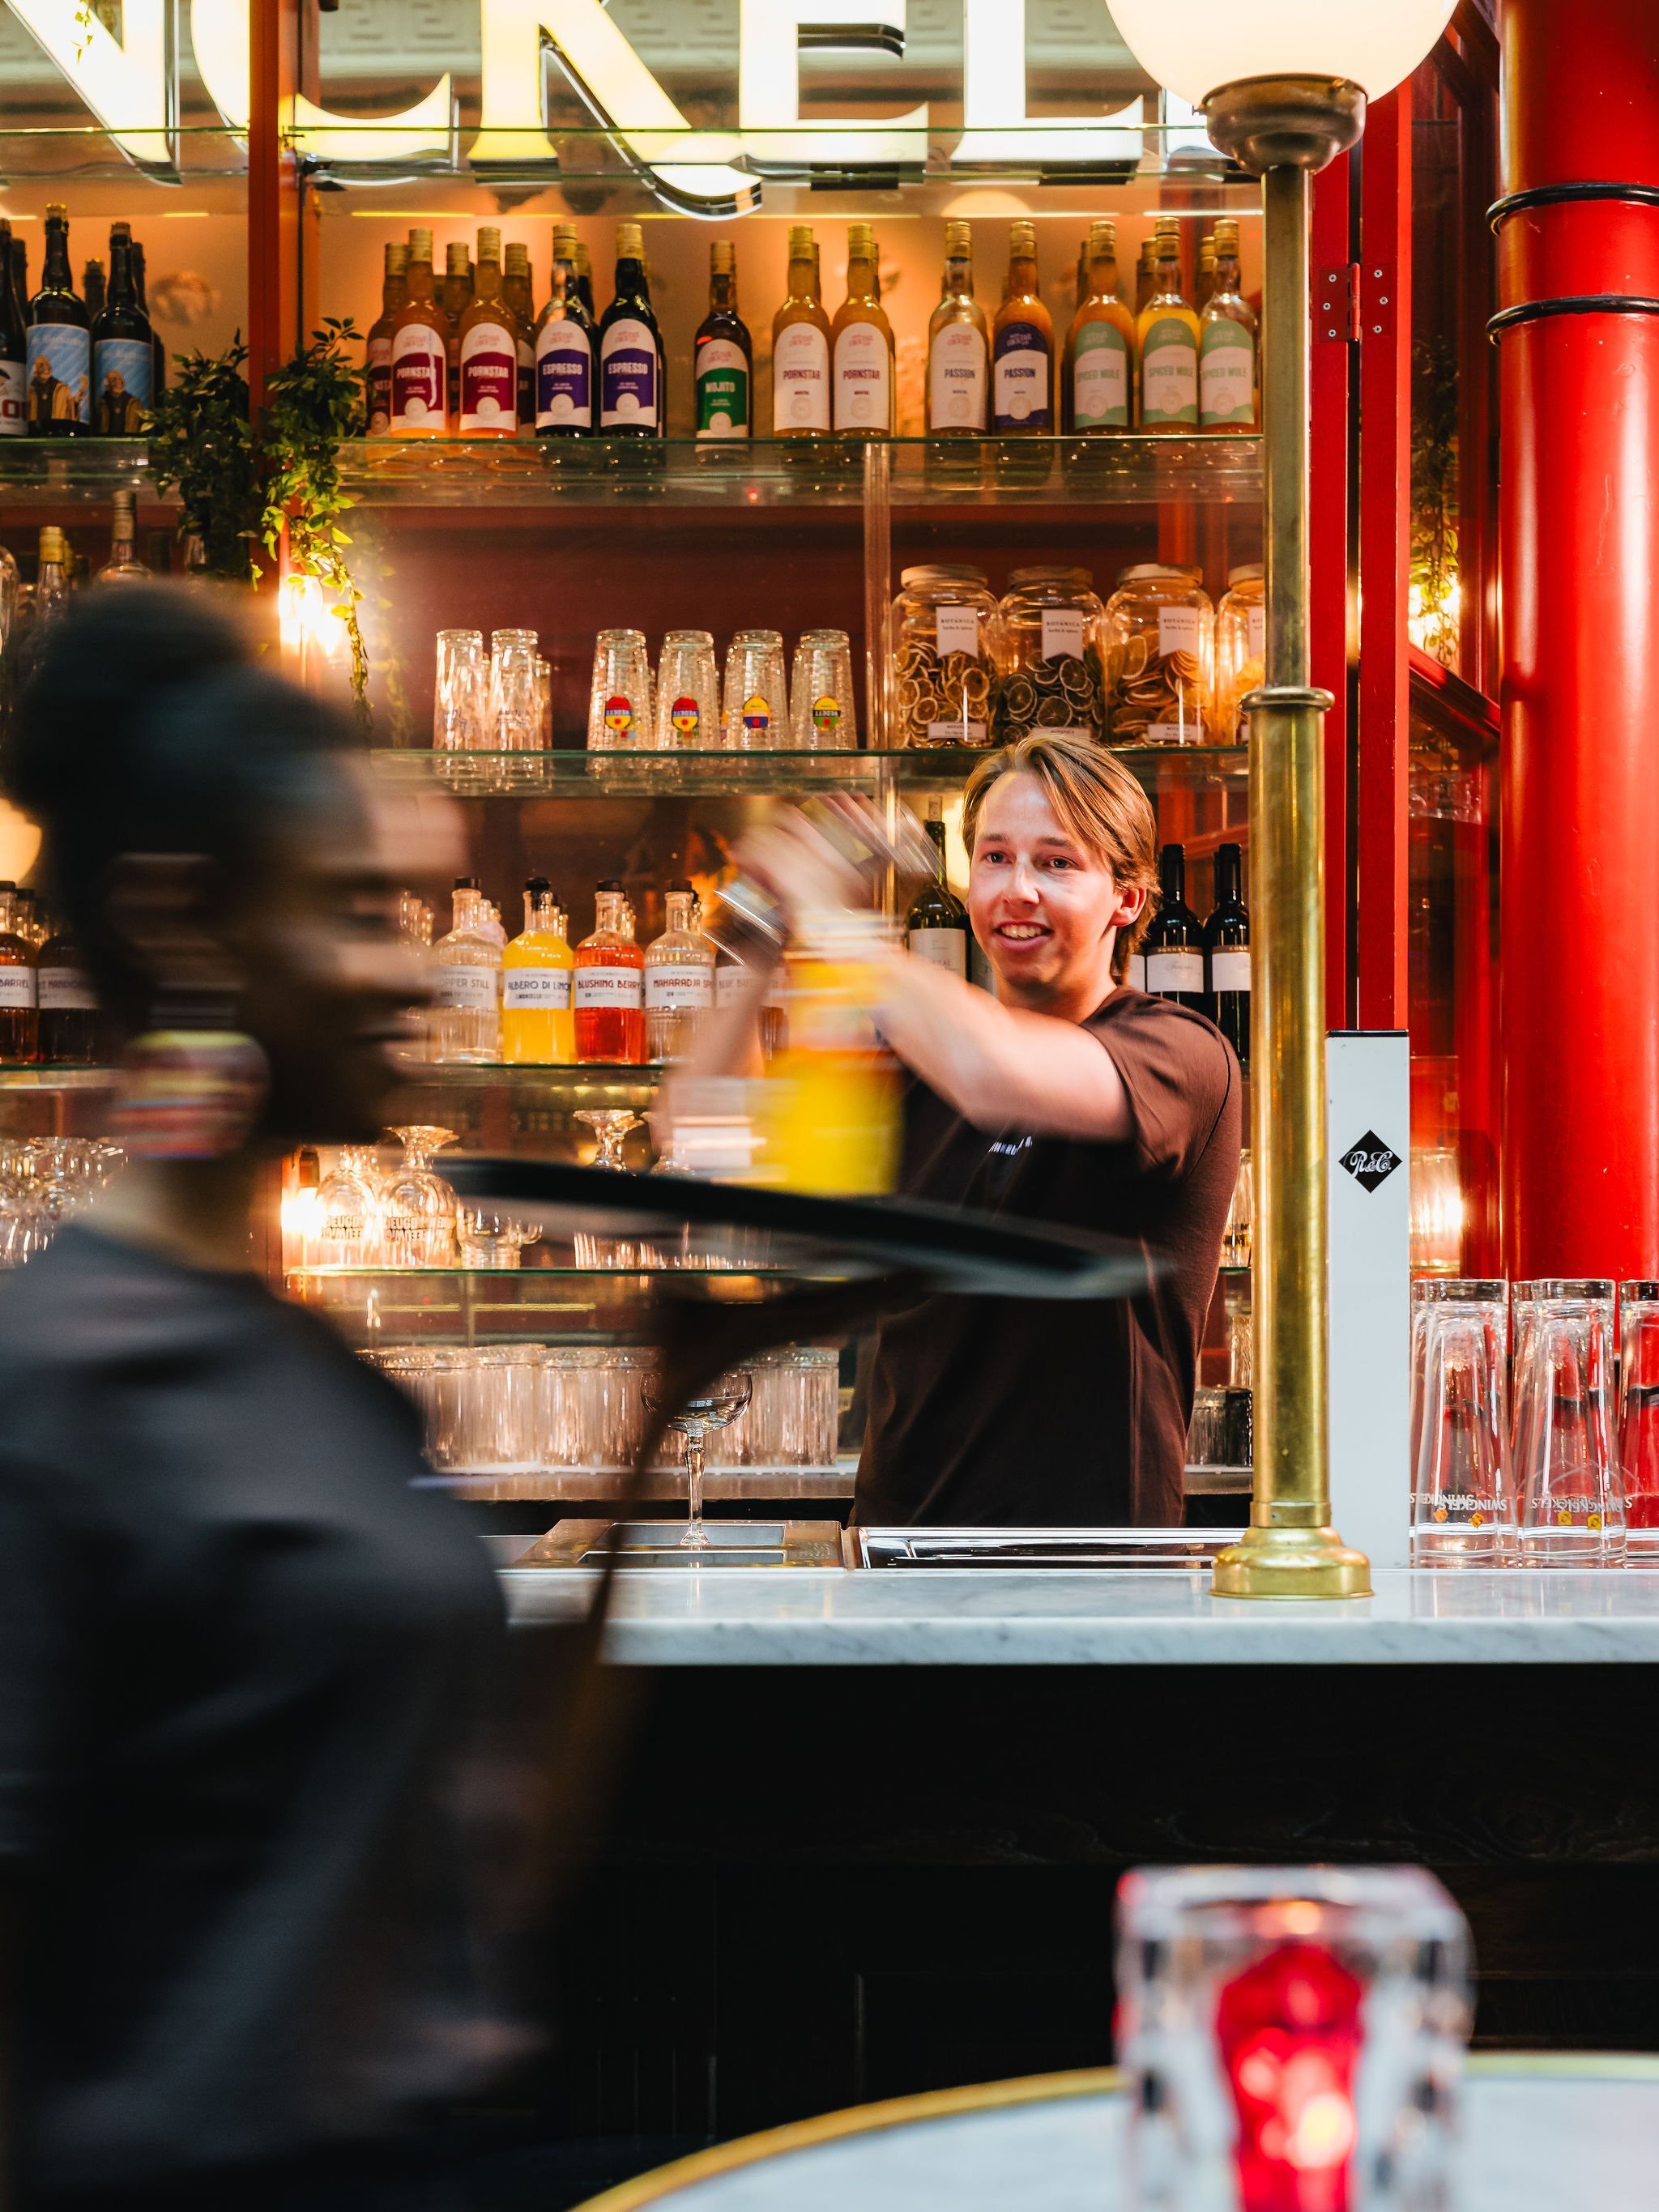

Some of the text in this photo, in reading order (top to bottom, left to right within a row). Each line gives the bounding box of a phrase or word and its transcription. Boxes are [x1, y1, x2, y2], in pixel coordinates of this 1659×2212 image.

[467, 365, 509, 378] PORNSTAR
[543, 363, 582, 375] ESPRESSO
[608, 363, 648, 375] ESPRESSO
[783, 369, 821, 380] PORNSTAR
[842, 369, 880, 380] PORNSTAR
[945, 369, 975, 378] PASSION
[1004, 368, 1036, 378] PASSION
[705, 382, 736, 393] MOJITO
[471, 978, 489, 989] STILL
[508, 980, 539, 991] ALBERO
[542, 980, 551, 990] DI
[578, 979, 641, 990] BLUSHING BERRY
[654, 978, 700, 988] MAHARADJA
